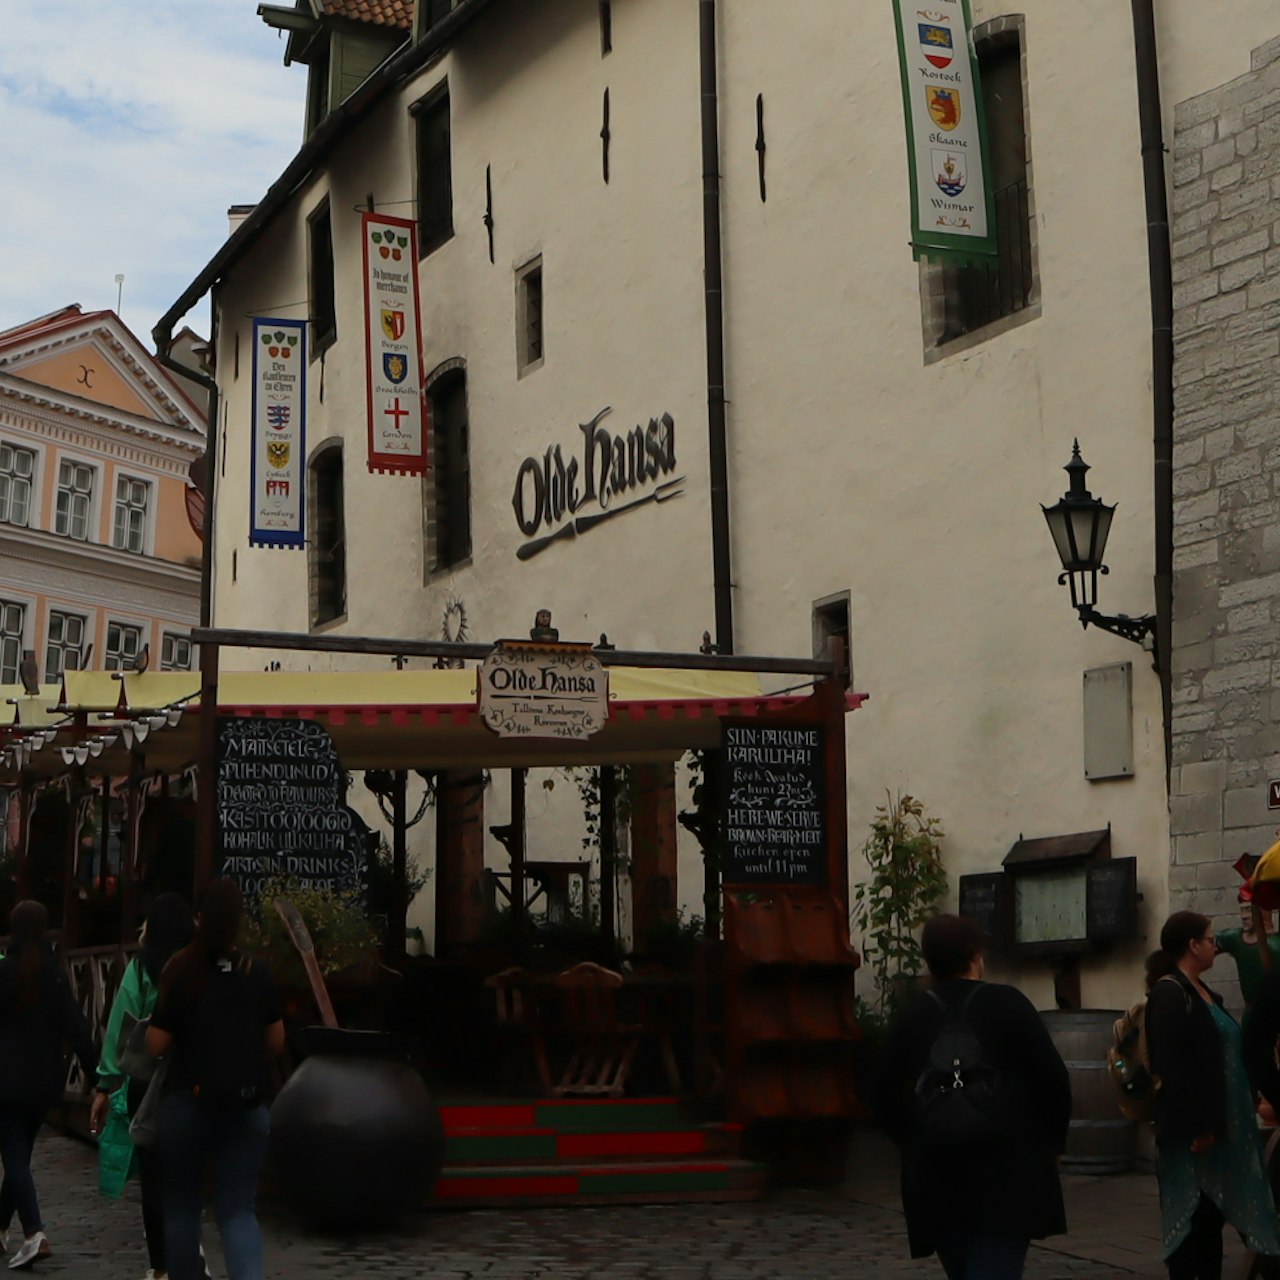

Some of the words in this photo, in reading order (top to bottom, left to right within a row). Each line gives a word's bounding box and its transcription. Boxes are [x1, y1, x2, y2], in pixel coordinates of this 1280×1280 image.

[918, 68, 962, 82] Rostock
[928, 133, 967, 147] Skaane
[931, 198, 974, 213] Wismar
[512, 443, 578, 537] Olde
[489, 668, 536, 690] Olde
[783, 847, 810, 861] open
[287, 856, 350, 873] DRINKS
[745, 858, 772, 873] until
